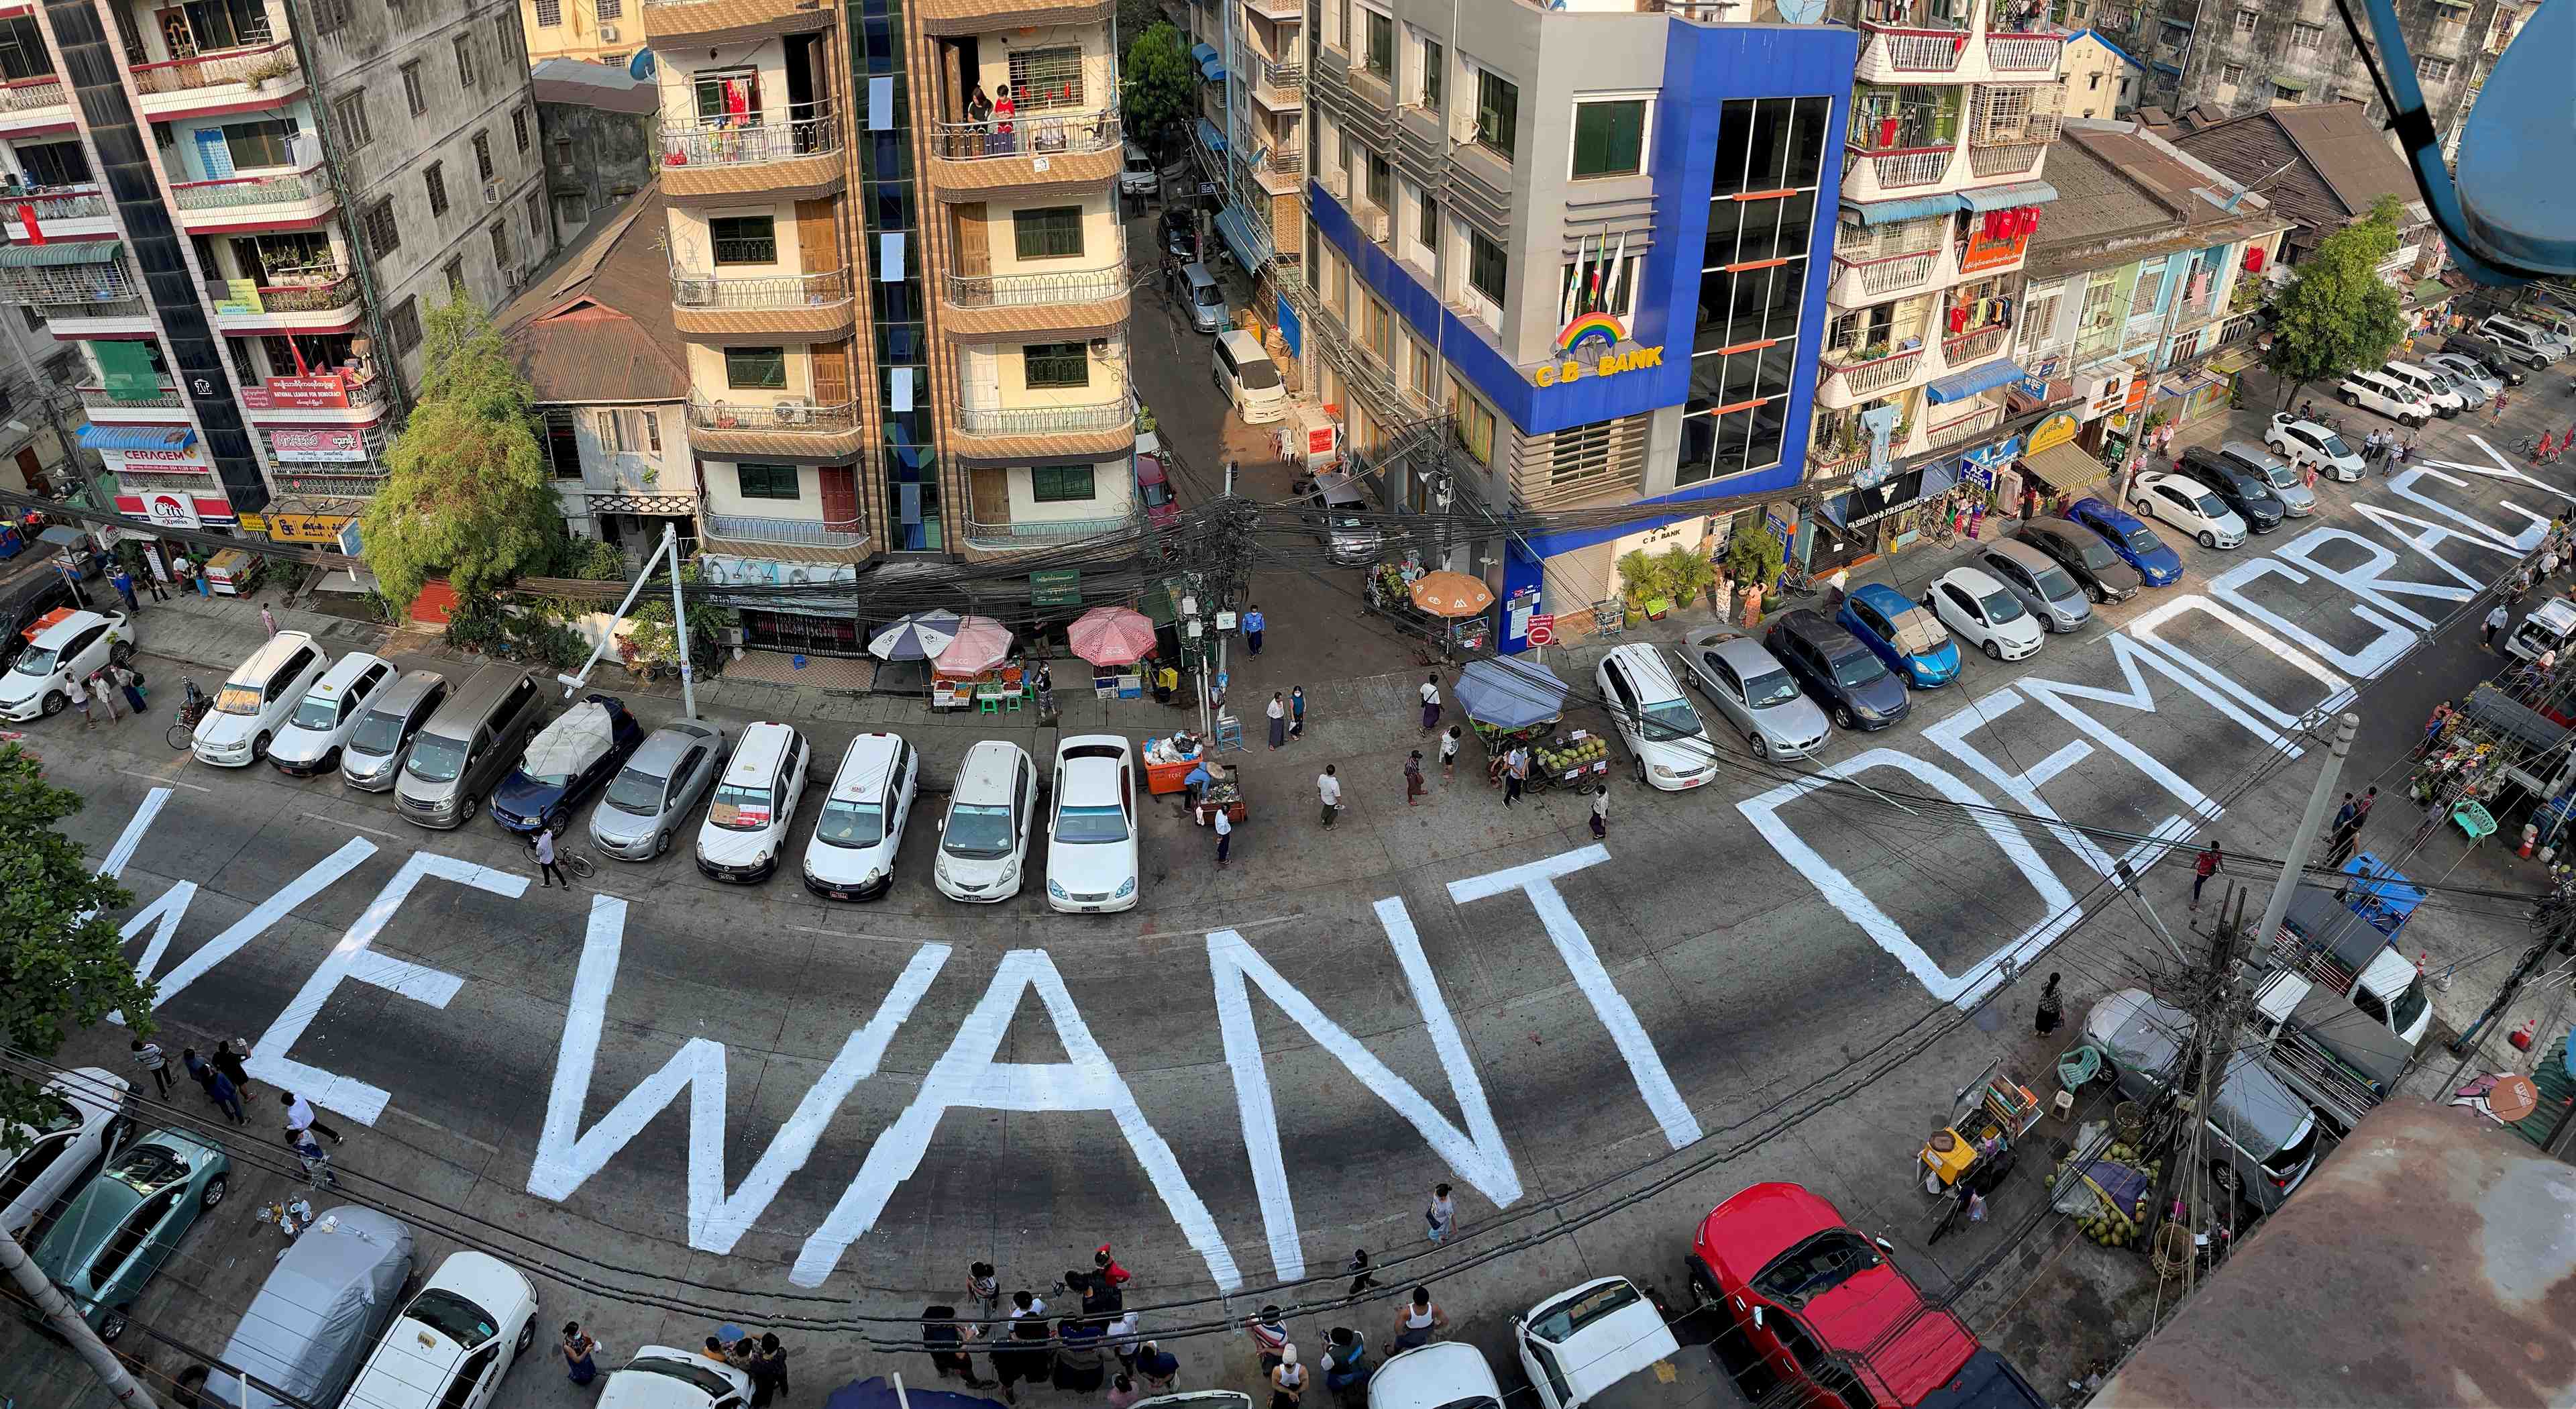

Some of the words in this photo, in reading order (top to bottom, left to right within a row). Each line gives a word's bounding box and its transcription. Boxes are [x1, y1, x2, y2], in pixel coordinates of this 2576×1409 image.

[1599, 346, 1664, 376] BANK
[125, 450, 185, 461] CERAGEM
[154, 503, 184, 519] City
[1661, 527, 1681, 539] BANK
[1735, 432, 2576, 1011] DEMOCRACY
[70, 786, 531, 1128] WE
[526, 843, 1703, 1295] WANT
